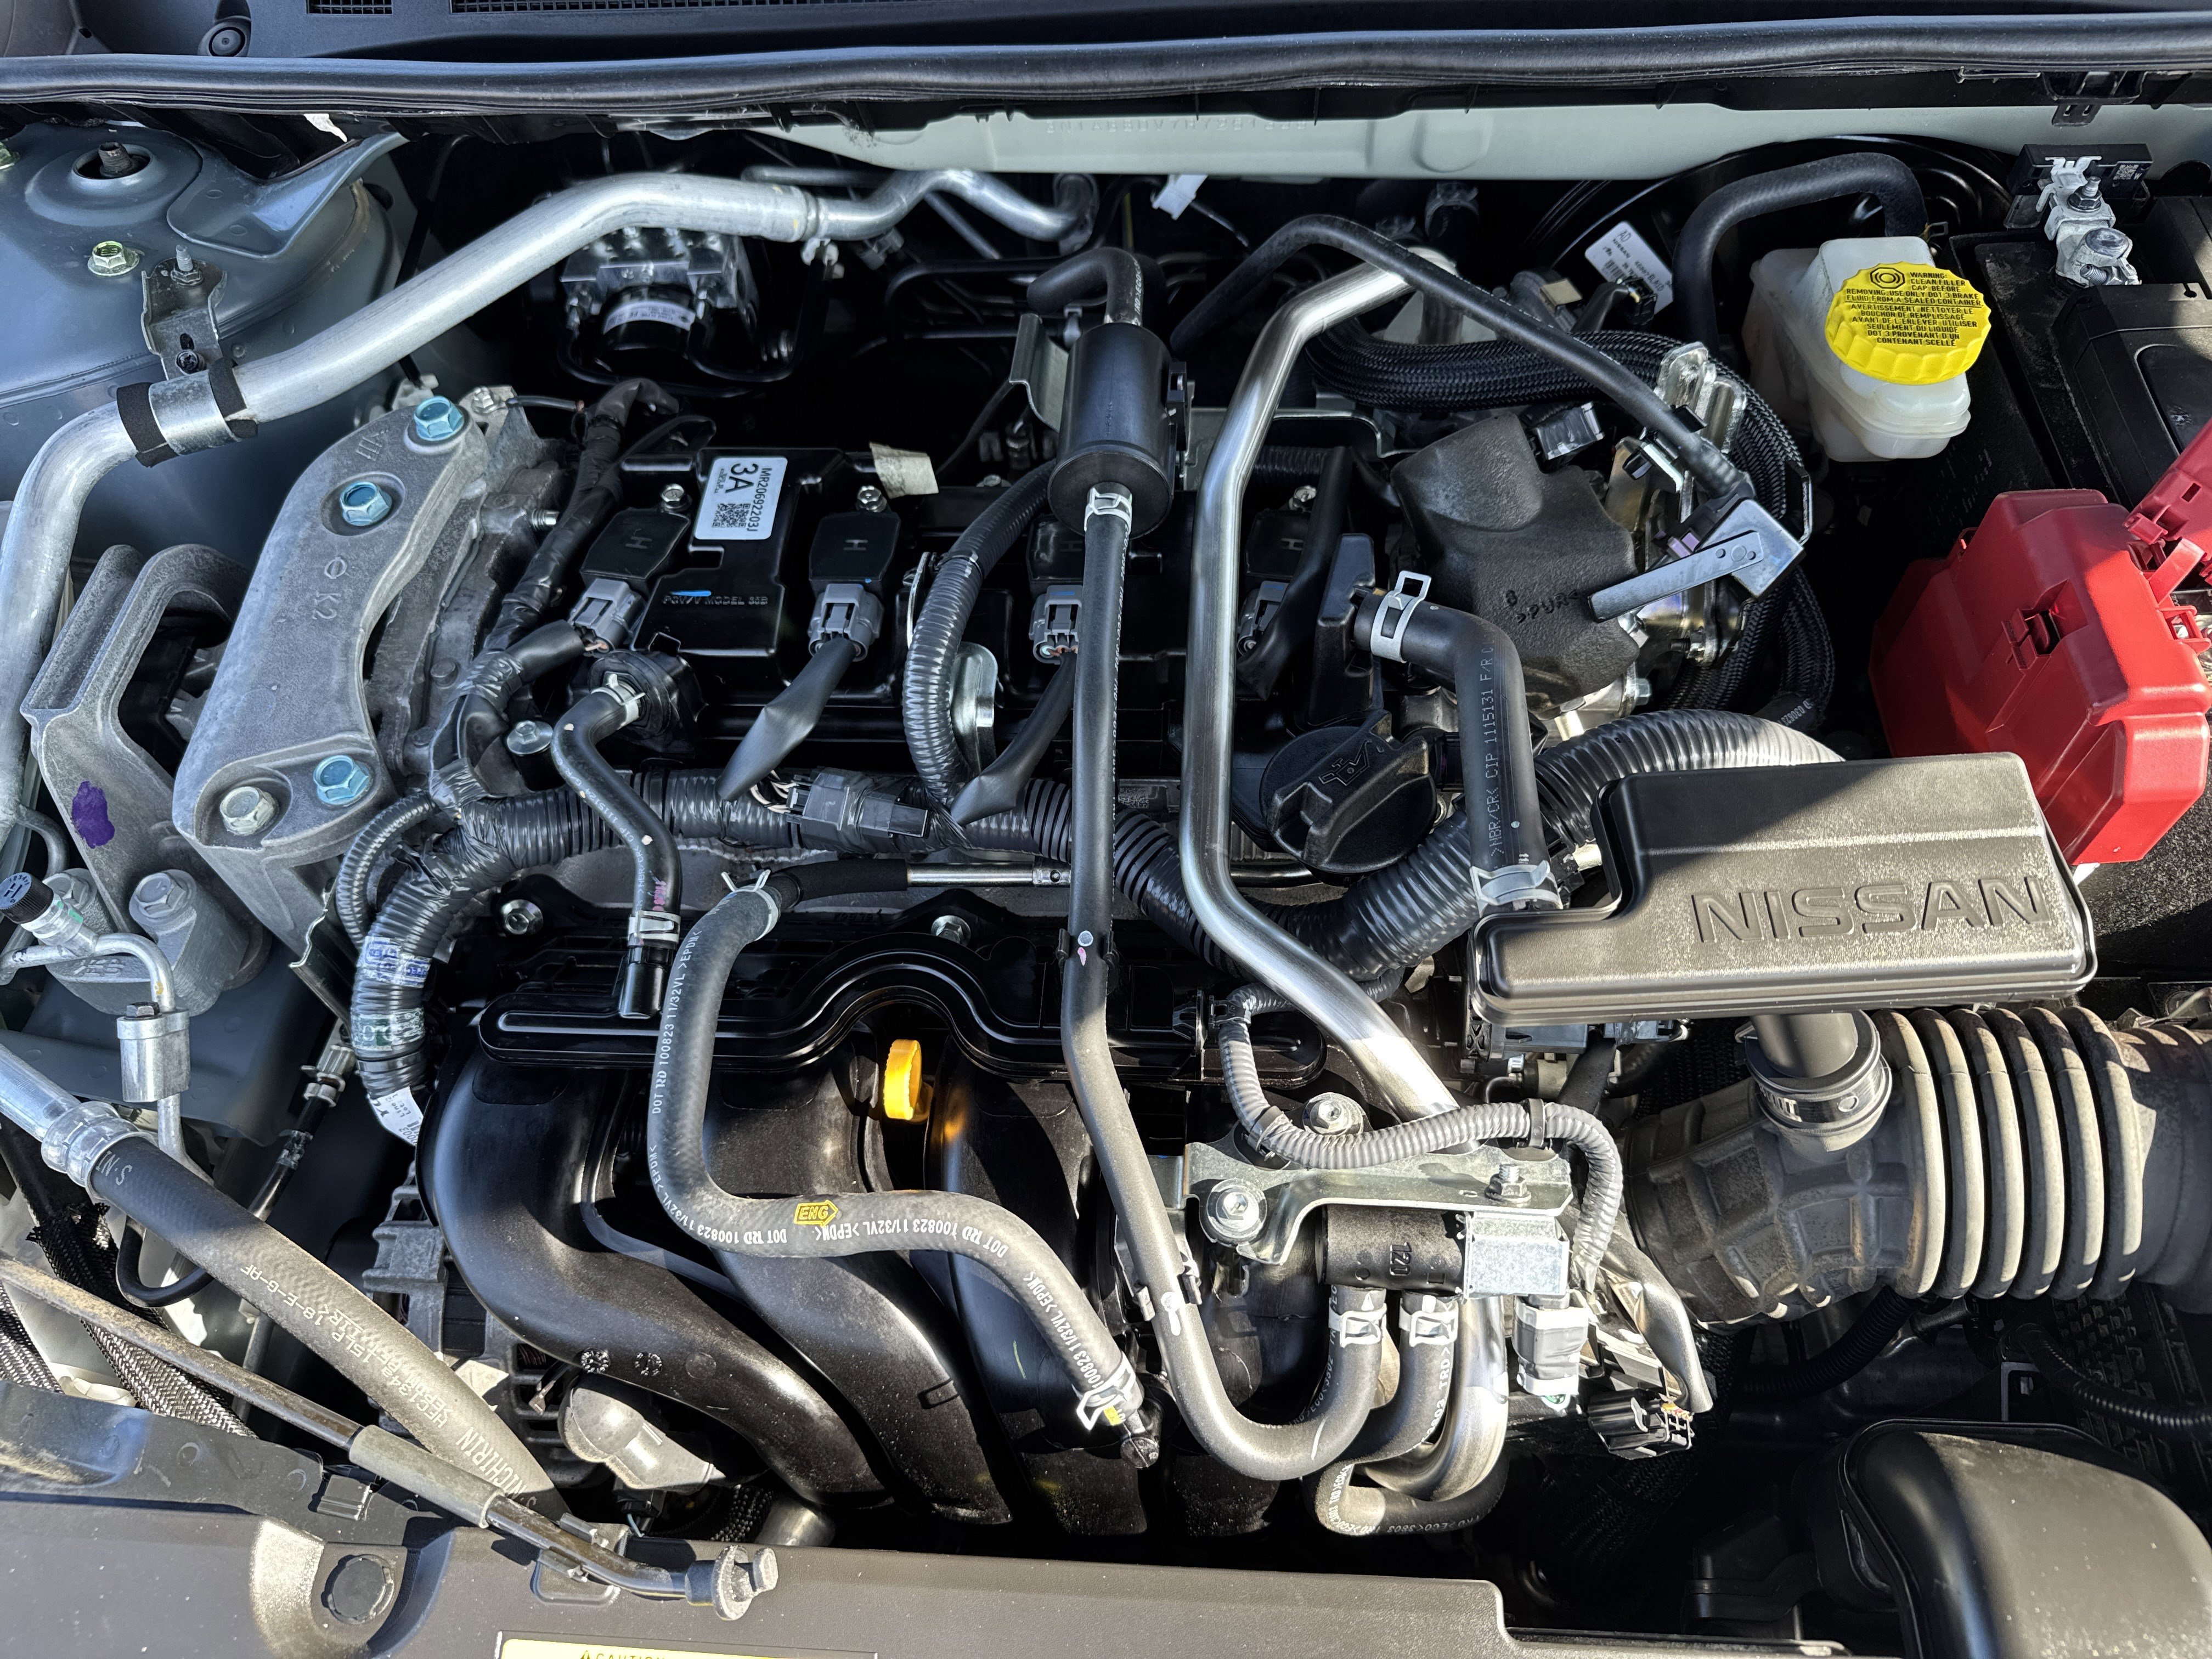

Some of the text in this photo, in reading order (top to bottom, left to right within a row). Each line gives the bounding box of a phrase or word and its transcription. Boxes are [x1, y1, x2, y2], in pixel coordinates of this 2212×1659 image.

[725, 463, 759, 494] 3A
[747, 467, 773, 532] MR20692203J
[1482, 689, 1497, 744] 1115131
[1486, 754, 1499, 778] CIP
[1691, 876, 2052, 943] NISSAN
[652, 1094, 664, 1114] DOT
[659, 1024, 675, 1066] 100823
[667, 973, 686, 1018] 11/32VL
[799, 1205, 829, 1220] ENG
[862, 1218, 909, 1235] 11/32VL
[697, 1224, 740, 1244] 100823
[767, 1229, 787, 1244] DOT
[913, 1218, 958, 1240] 100823
[984, 1235, 1009, 1258] DOT
[1390, 1242, 1412, 1276] 120
[240, 1264, 324, 1325] 18-E-G-AF
[1051, 1310, 1079, 1352] 11/32VL
[1073, 1350, 1104, 1389] 100823
